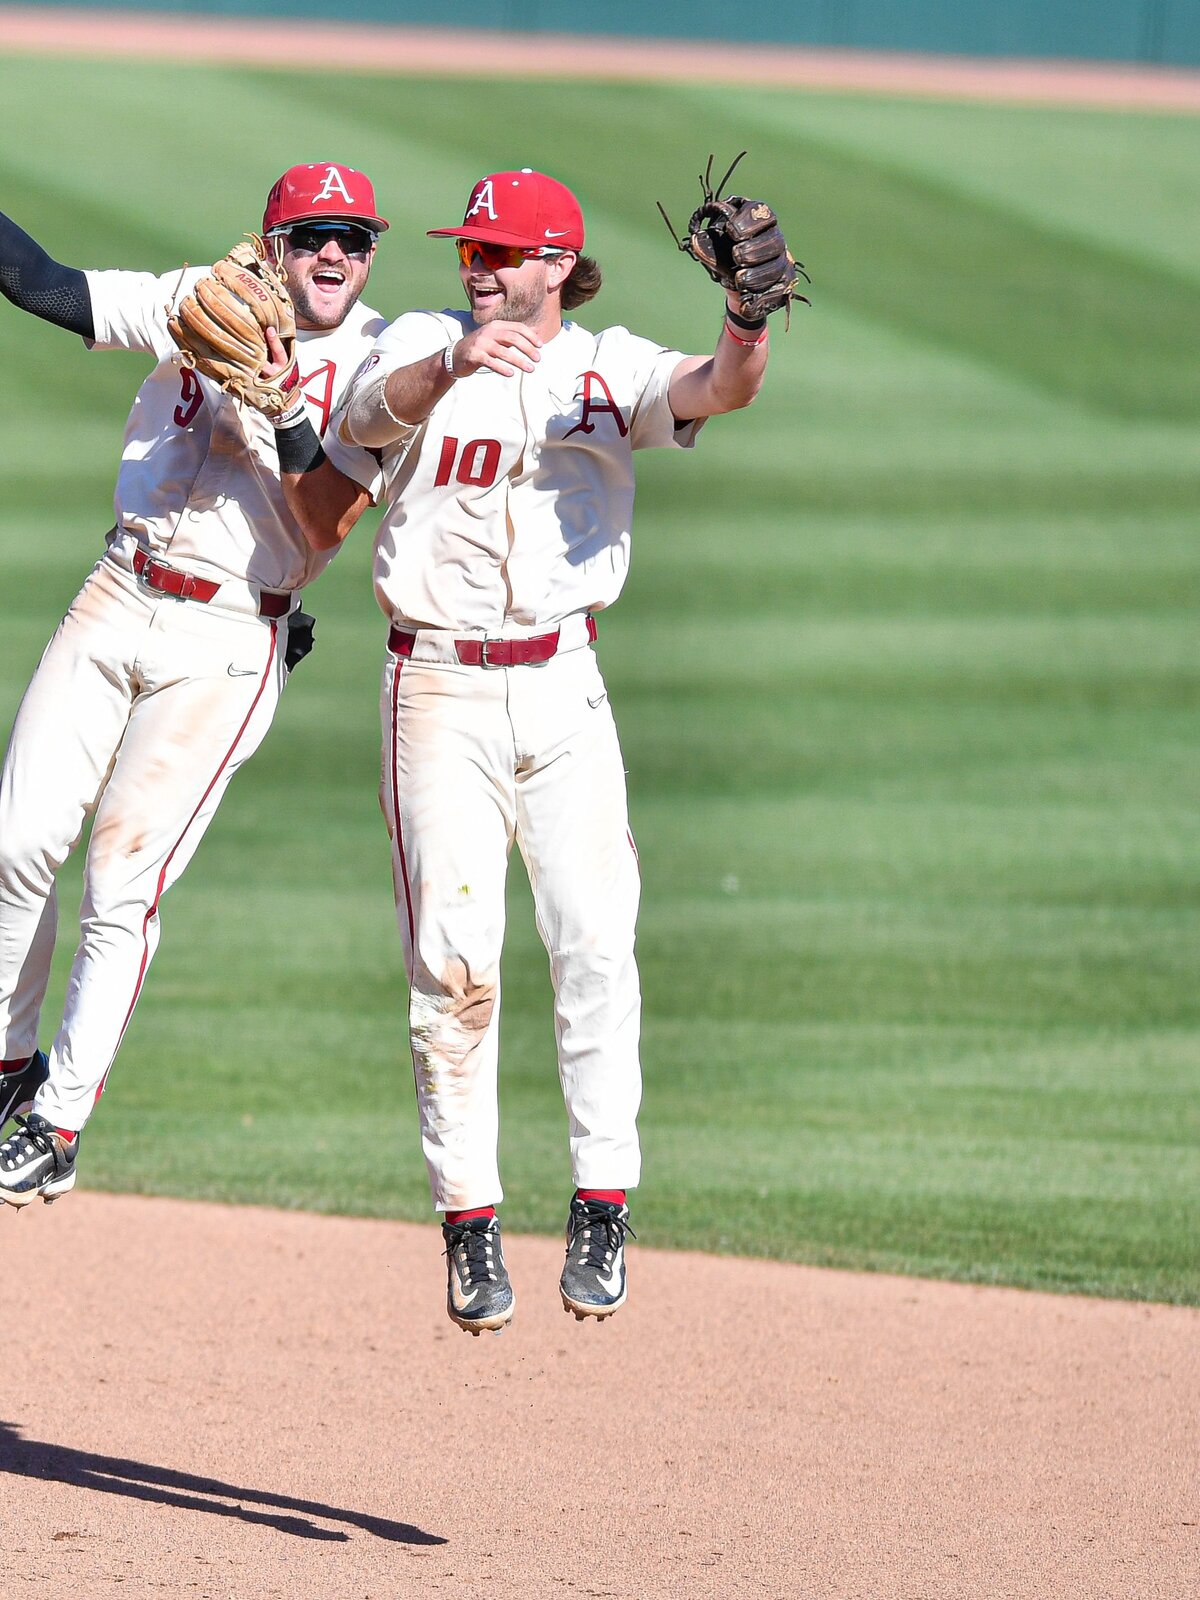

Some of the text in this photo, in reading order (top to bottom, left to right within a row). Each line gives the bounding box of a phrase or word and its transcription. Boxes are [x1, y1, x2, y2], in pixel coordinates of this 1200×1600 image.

[311, 166, 355, 204] A
[465, 180, 498, 220] A
[235, 273, 268, 302] A2000
[173, 366, 204, 428] 9
[299, 359, 336, 438] A
[562, 370, 629, 440] A
[434, 435, 502, 488] 10
